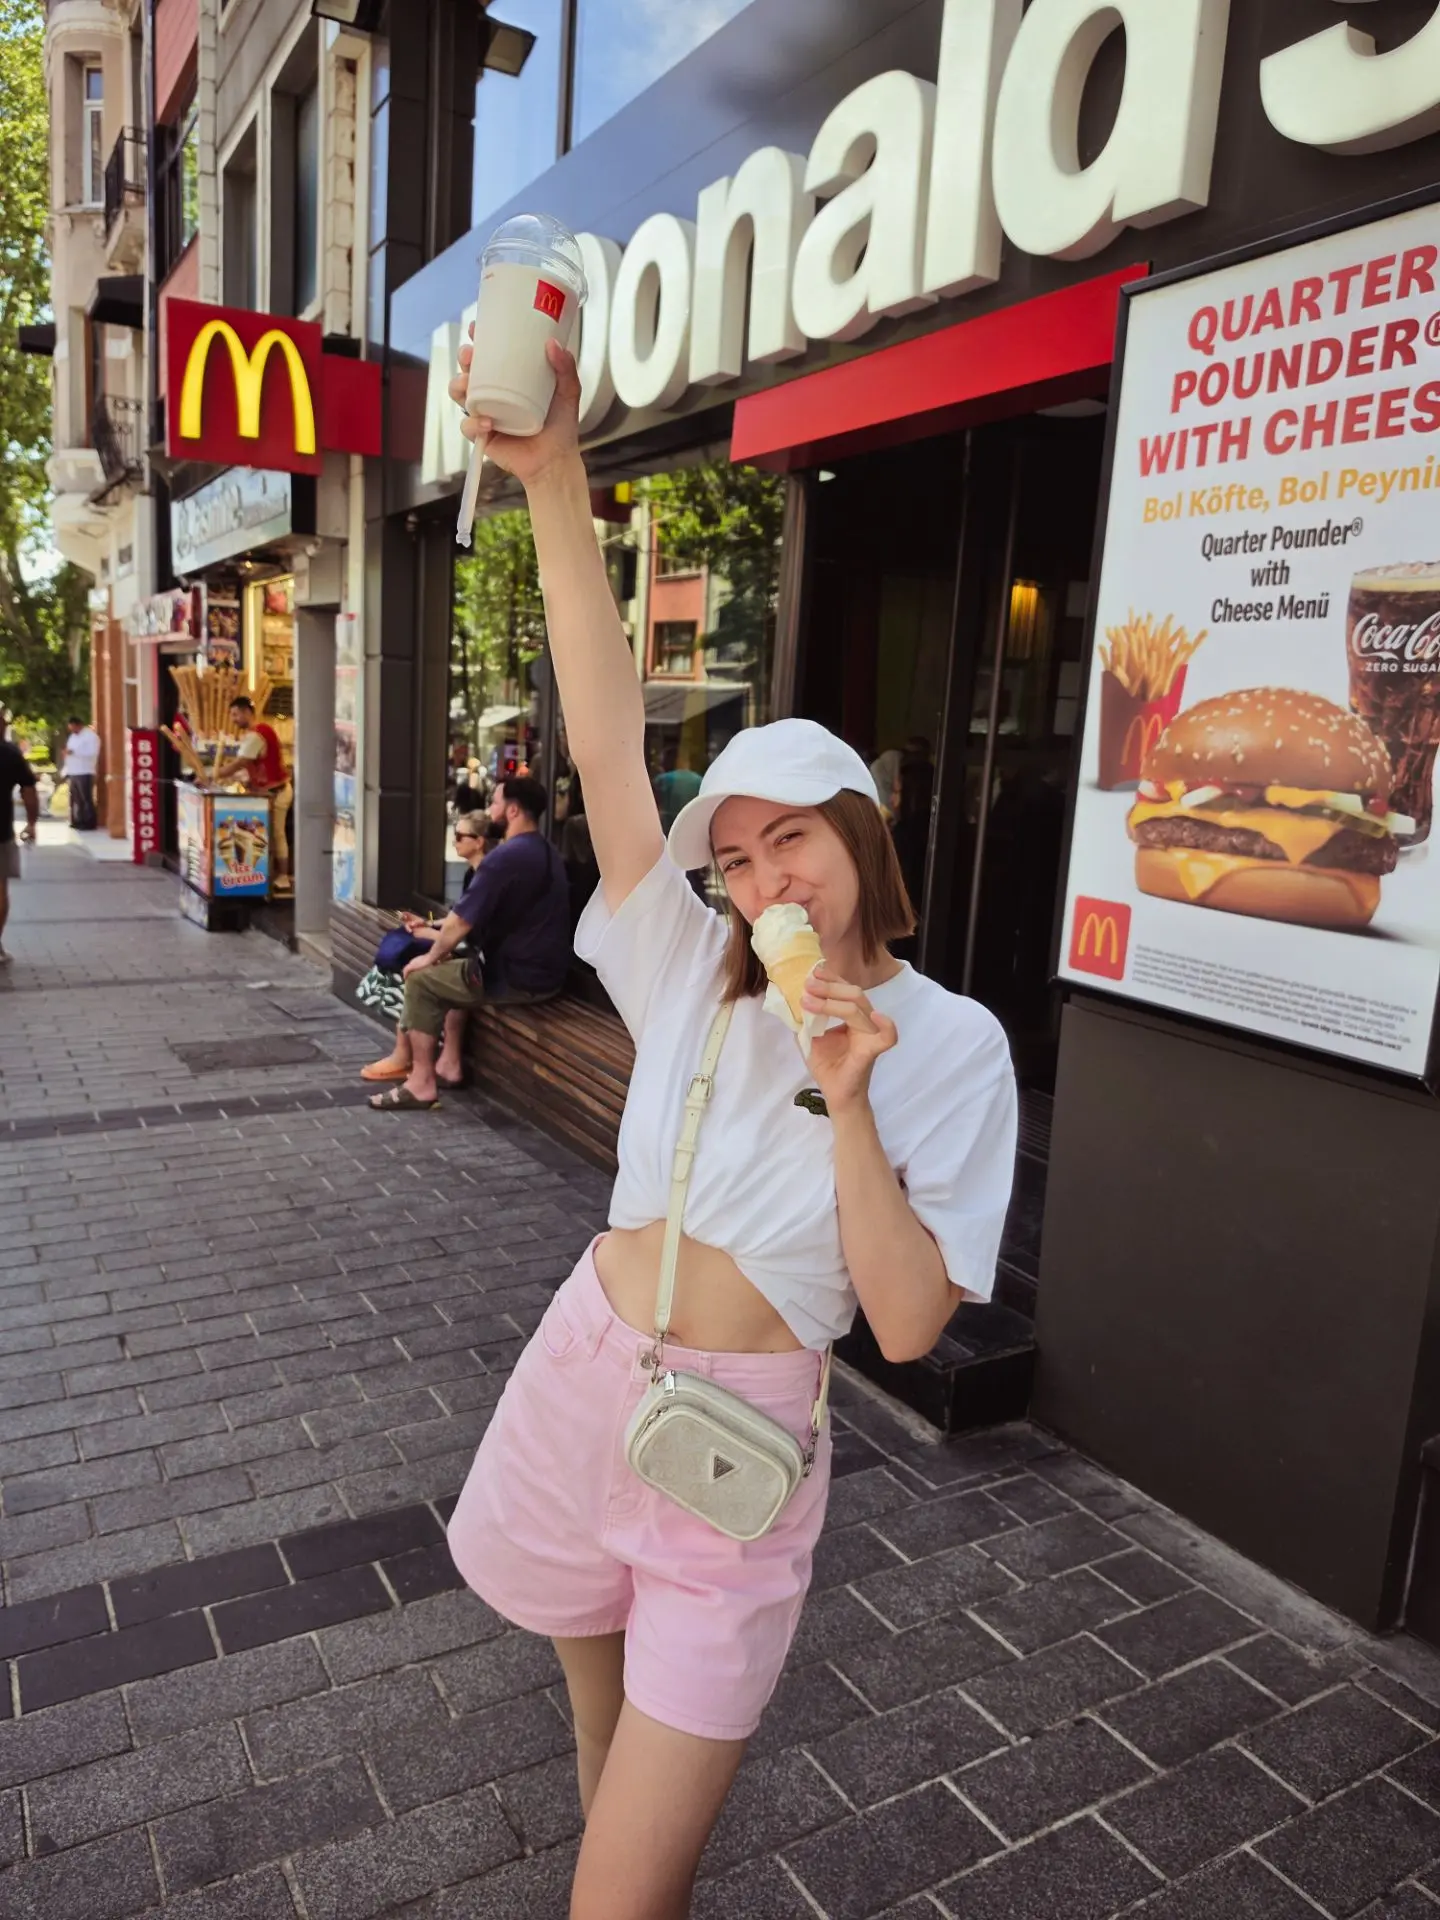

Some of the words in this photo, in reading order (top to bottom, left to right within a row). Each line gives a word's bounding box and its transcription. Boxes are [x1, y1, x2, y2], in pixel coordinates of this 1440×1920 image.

[1188, 244, 1438, 355] QUARTER
[1139, 416, 1252, 478] WITH
[1143, 491, 1182, 524] Bol
[1189, 481, 1270, 517] Köfte,
[1279, 471, 1329, 507] Bol
[1201, 528, 1267, 562] Quarter
[1250, 560, 1290, 588] with
[1211, 597, 1274, 624] Cheese
[1278, 592, 1331, 621] Menü
[1365, 661, 1398, 673] ZERO
[1402, 662, 1440, 673] SUGA
[137, 739, 155, 852] BOOKSHOP
